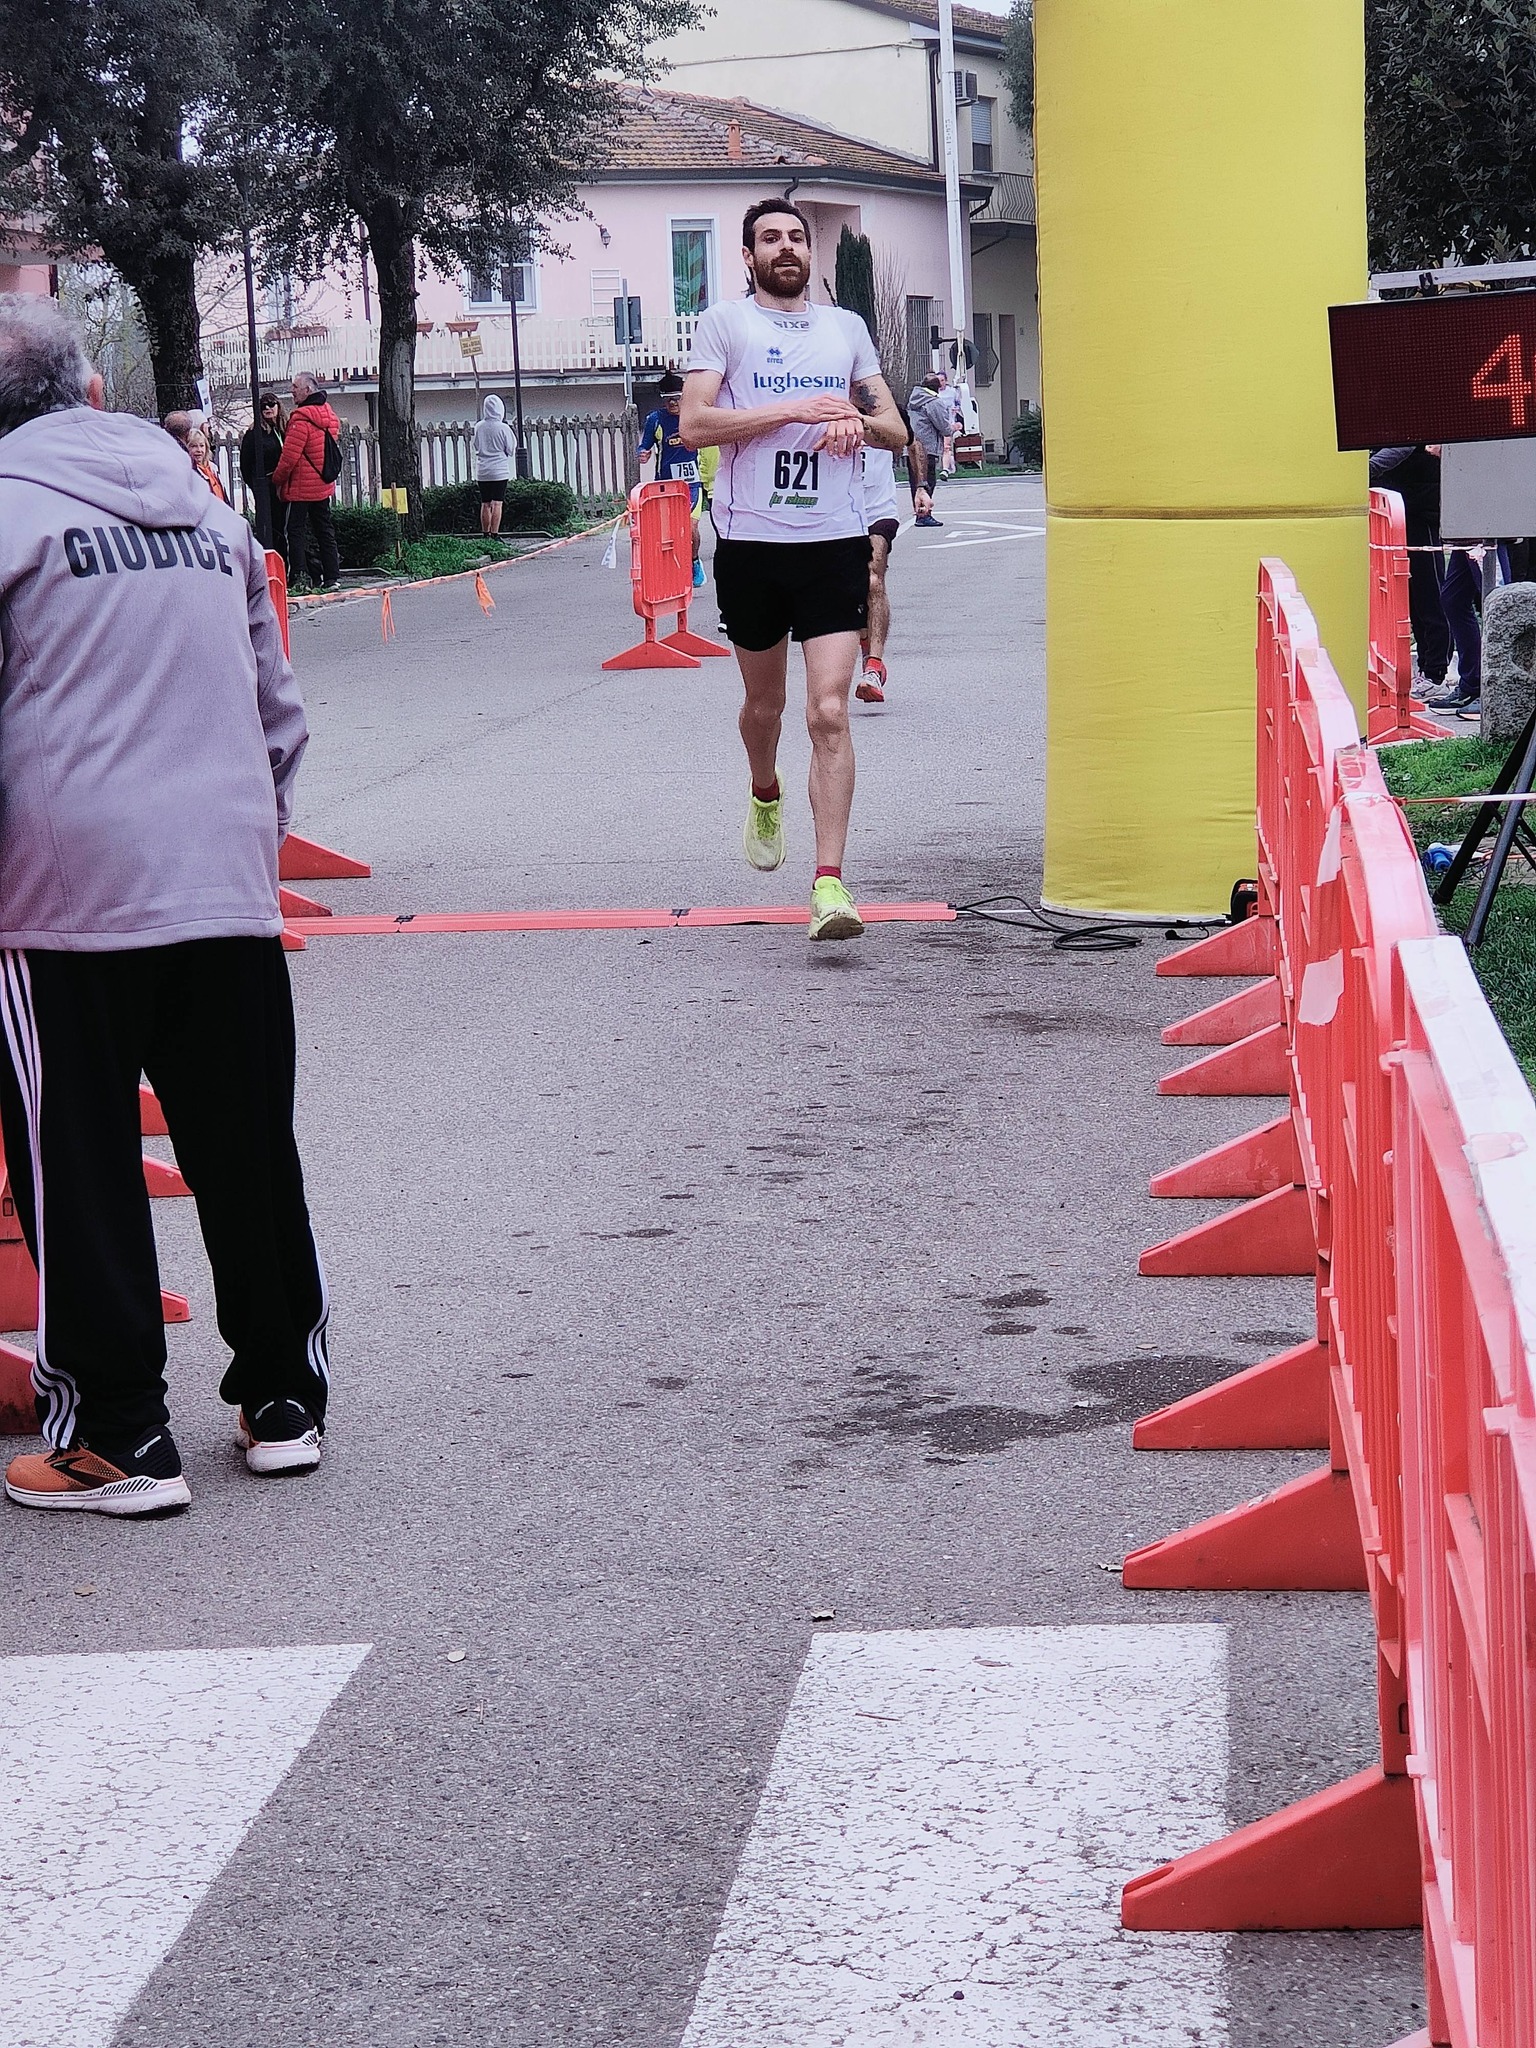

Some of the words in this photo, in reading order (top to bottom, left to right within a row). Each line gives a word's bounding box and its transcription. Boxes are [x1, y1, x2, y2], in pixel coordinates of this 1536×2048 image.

[753, 371, 846, 394] lughesina
[1472, 334, 1536, 425] 4
[676, 462, 695, 477] 759
[774, 450, 819, 491] 621
[63, 525, 233, 578] GIUDICE
